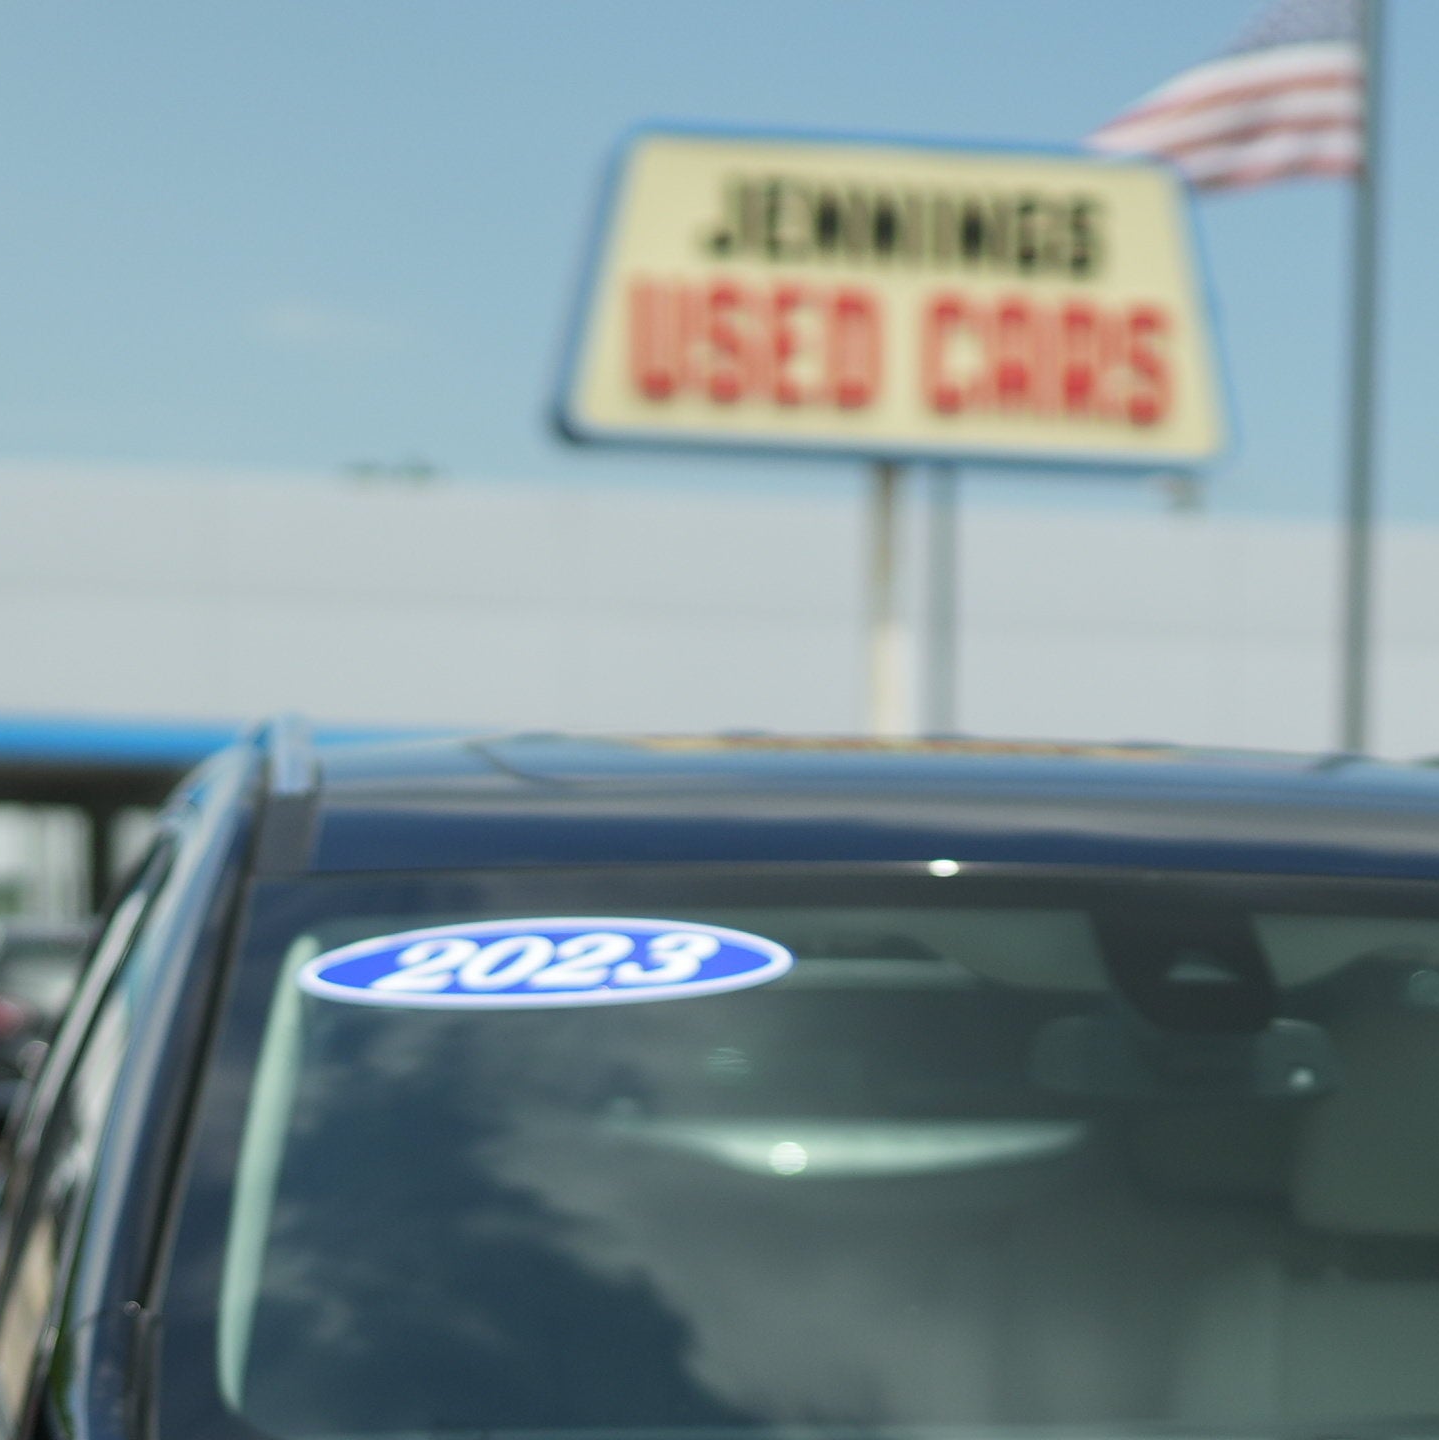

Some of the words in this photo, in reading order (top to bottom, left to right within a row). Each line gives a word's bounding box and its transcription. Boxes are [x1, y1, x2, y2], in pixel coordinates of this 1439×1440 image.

[701, 176, 1107, 277] JENNINGS
[629, 280, 881, 408] USED
[921, 293, 1173, 427] CARS
[369, 931, 721, 993] 2023
